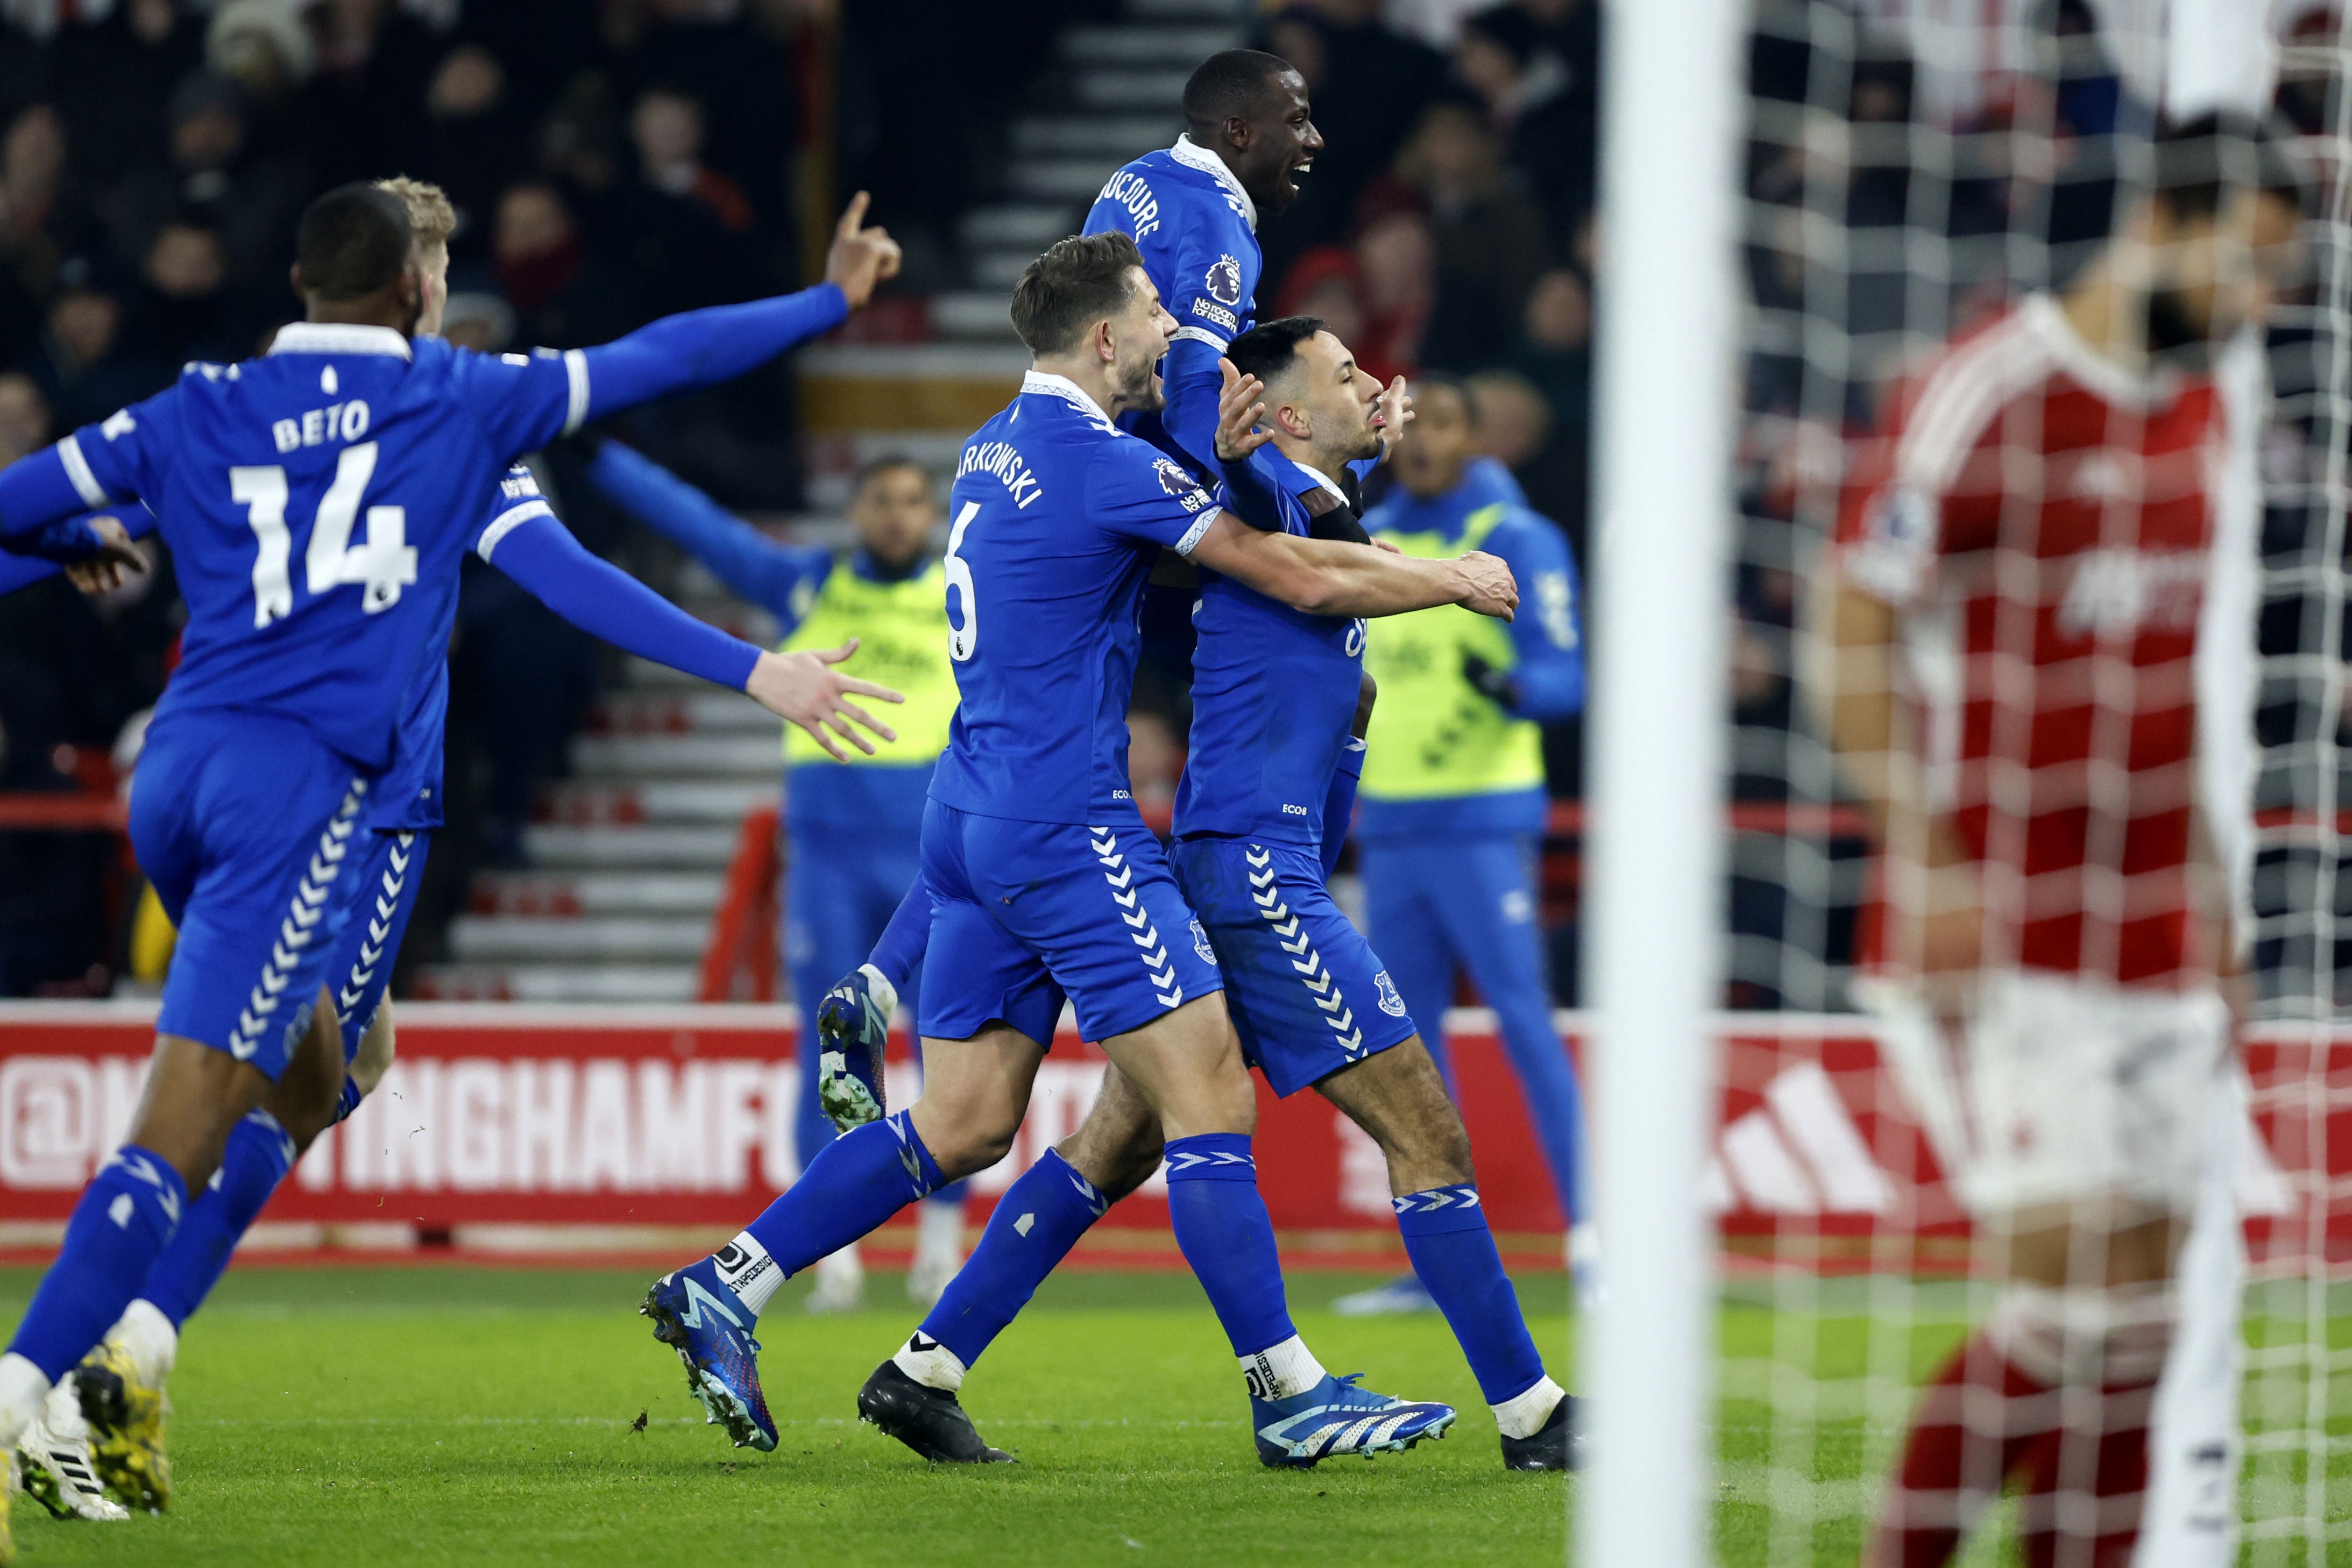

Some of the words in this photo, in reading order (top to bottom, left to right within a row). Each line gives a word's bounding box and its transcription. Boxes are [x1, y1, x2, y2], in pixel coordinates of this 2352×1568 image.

[1192, 306, 1208, 317] for
[1207, 312, 1237, 333] racism
[1194, 297, 1211, 310] No
[1210, 304, 1236, 323] room
[272, 399, 371, 454] BETO
[1179, 495, 1196, 508] No
[1186, 501, 1201, 513] for
[229, 440, 419, 630] 14
[938, 500, 982, 662] 6
[1282, 804, 1307, 815] ECO8
[1254, 1350, 1281, 1400] TAPEDESI
